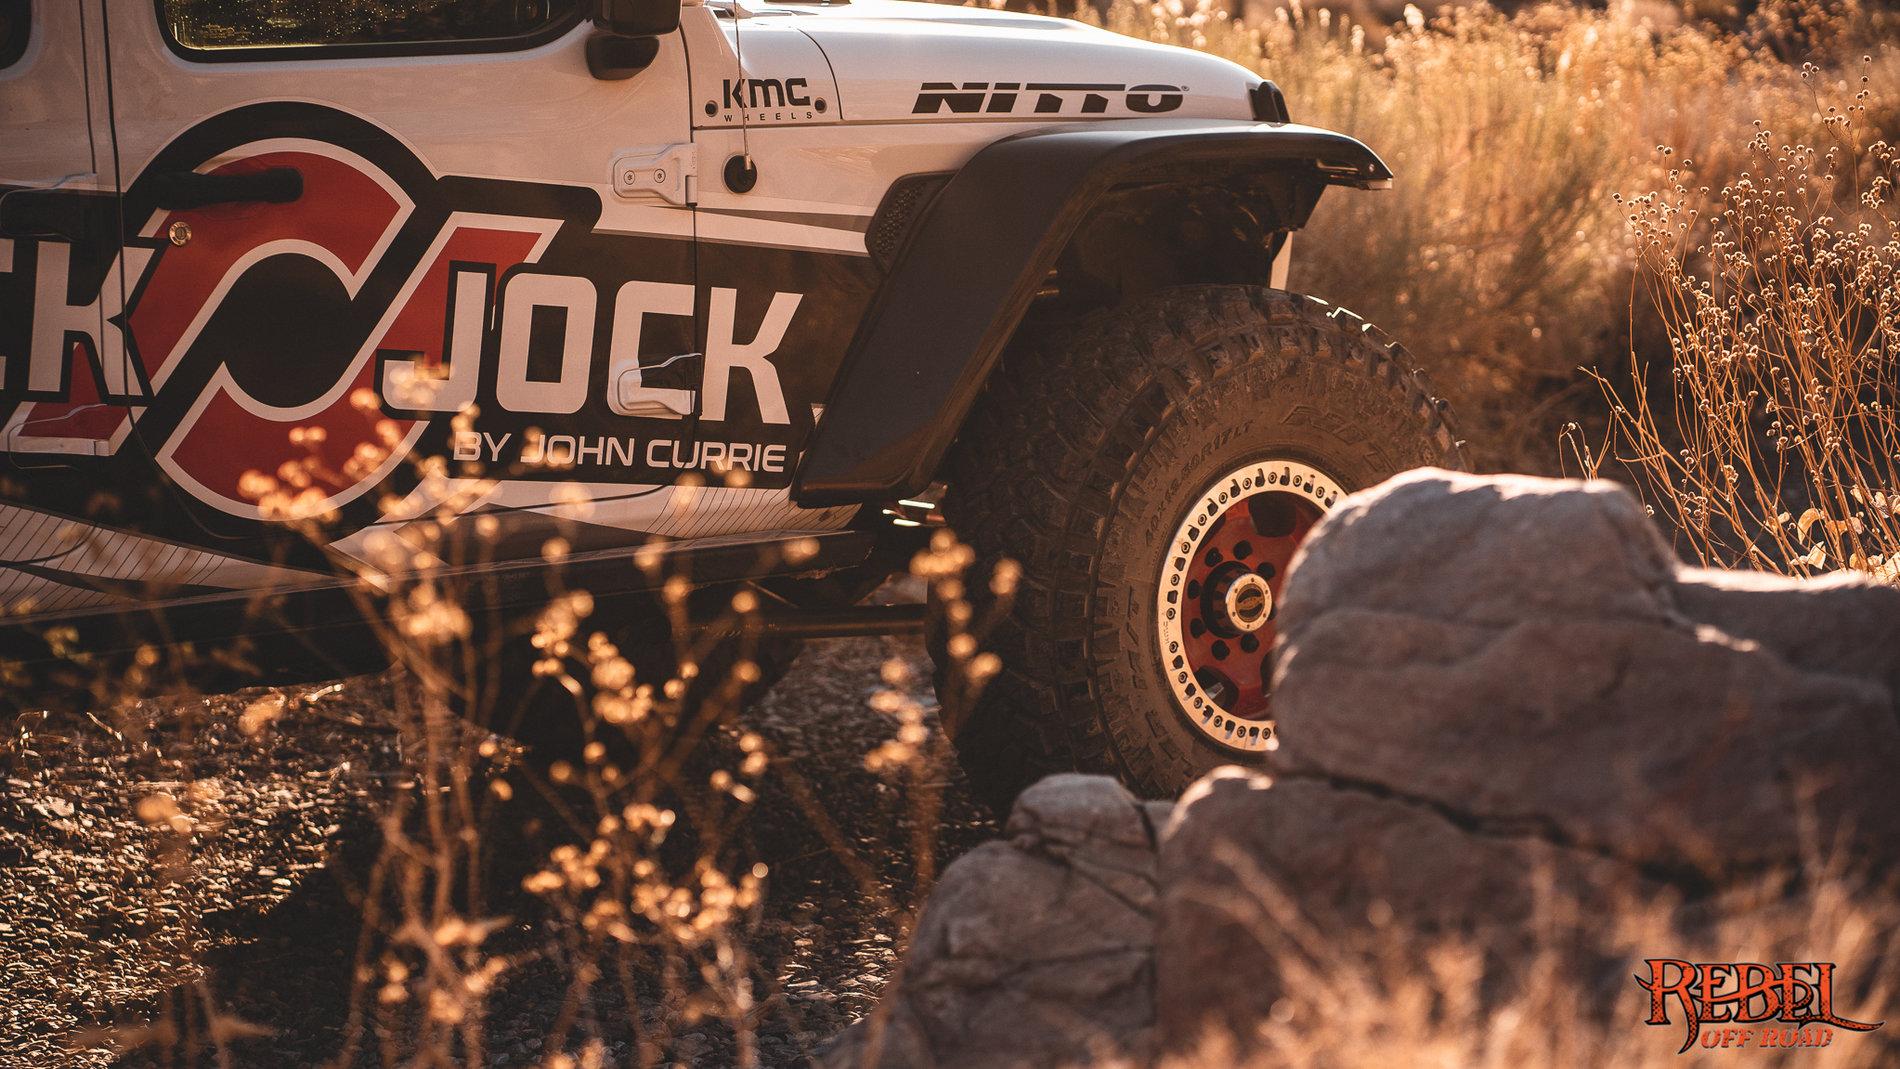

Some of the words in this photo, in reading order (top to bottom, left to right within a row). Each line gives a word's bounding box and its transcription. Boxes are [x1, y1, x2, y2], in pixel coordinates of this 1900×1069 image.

[723, 78, 811, 109] KMC
[912, 82, 1184, 114] NITTO
[724, 112, 813, 122] WHEELS
[0, 238, 156, 396] K
[382, 271, 804, 425] JOCK
[453, 431, 511, 462] BY
[520, 434, 635, 467] JOHN
[646, 439, 787, 473] CURRIE
